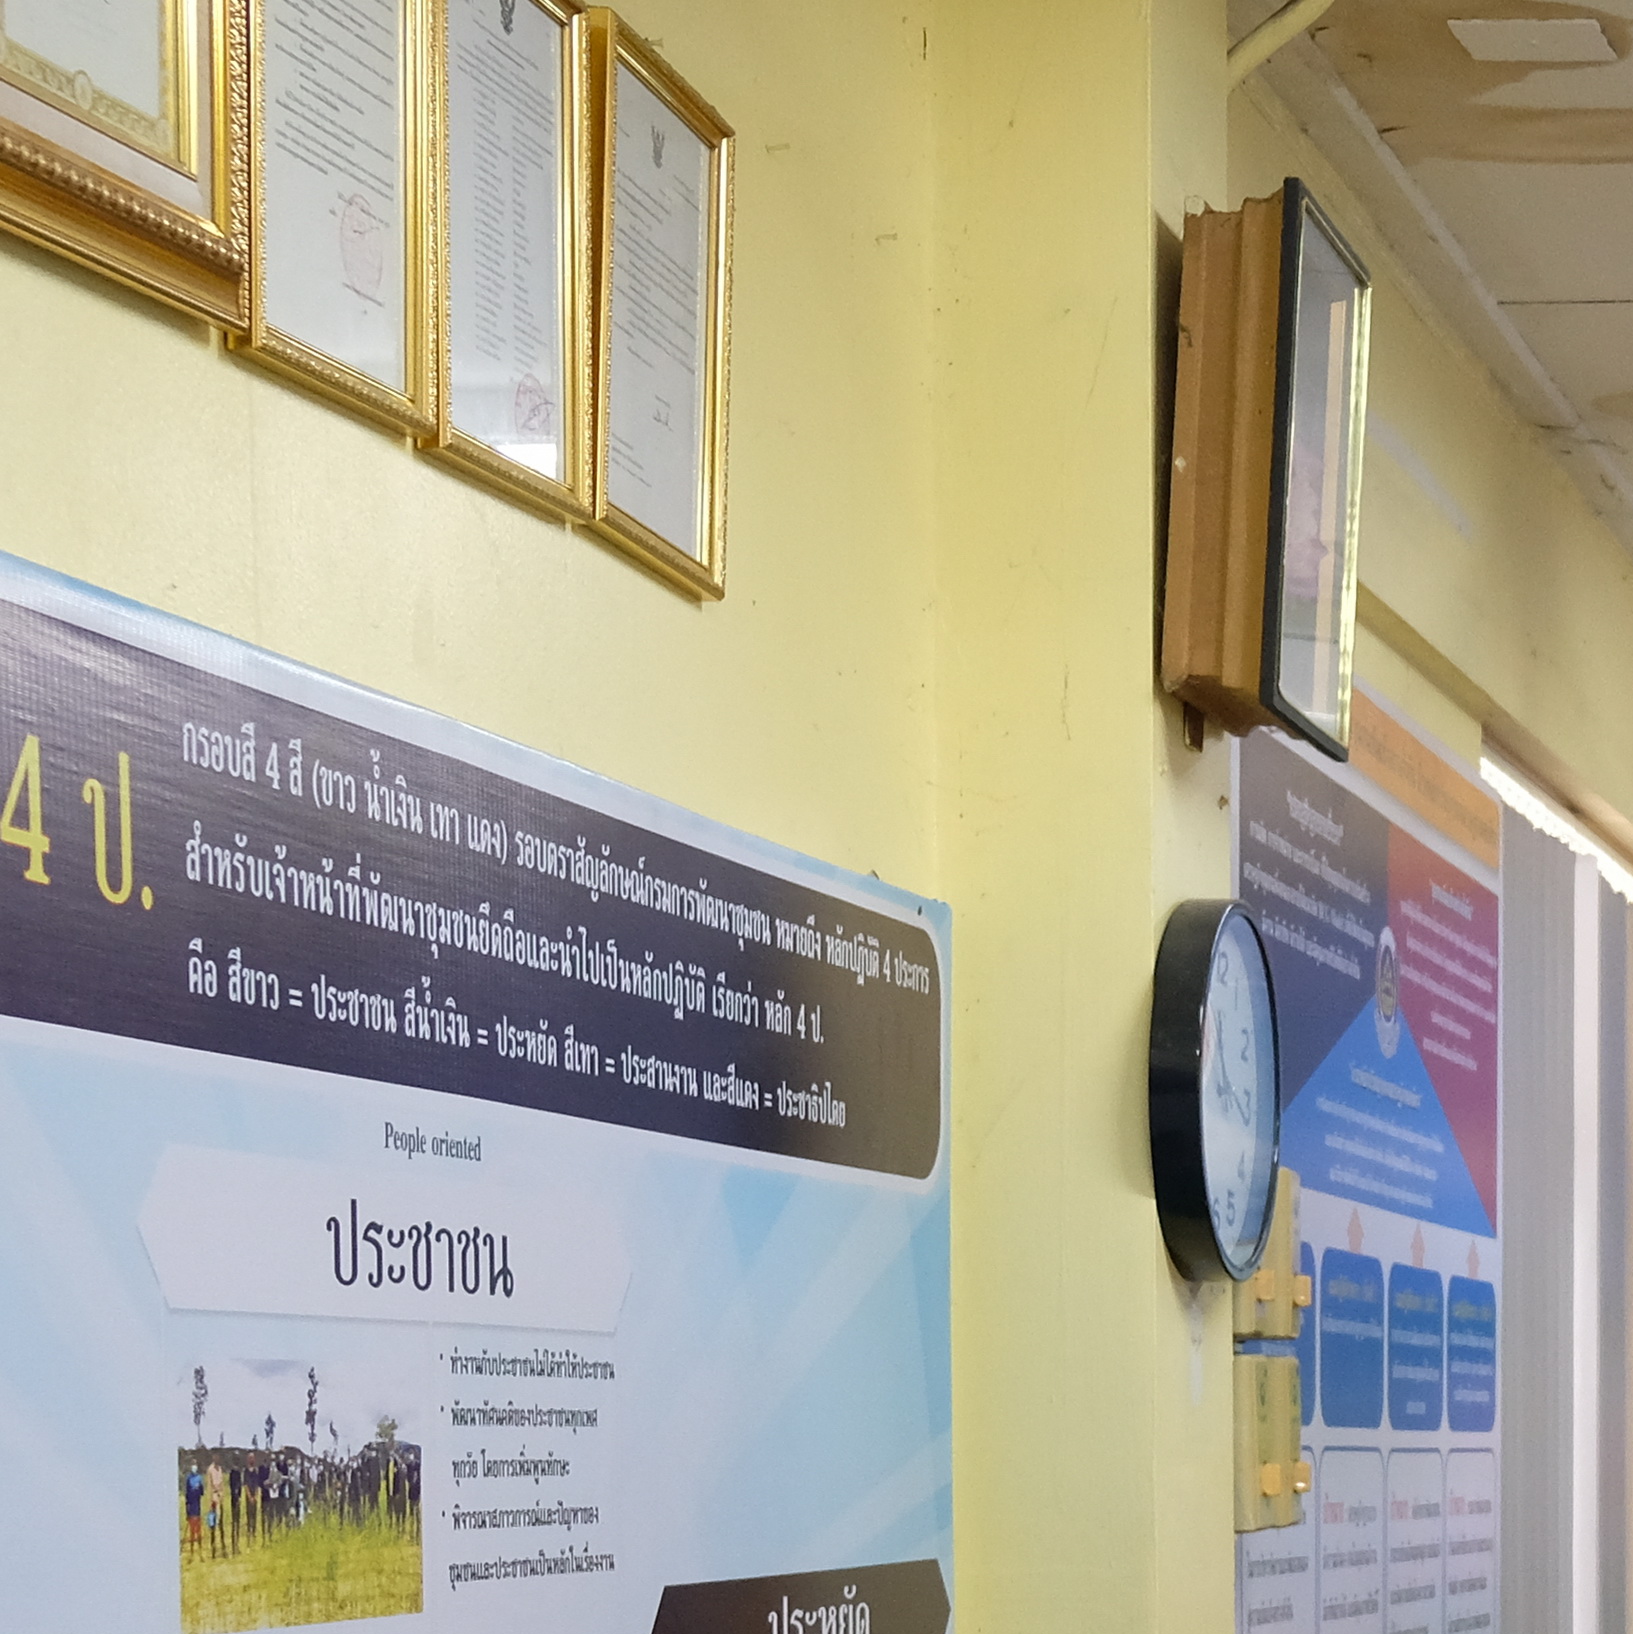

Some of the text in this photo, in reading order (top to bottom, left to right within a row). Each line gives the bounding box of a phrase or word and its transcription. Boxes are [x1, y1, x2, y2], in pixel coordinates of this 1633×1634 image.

[0, 734, 154, 911] 4 ป.
[183, 721, 256, 783] กรอบสี
[265, 742, 281, 791] 4
[289, 737, 303, 797] สี
[312, 758, 357, 815] (ขาว
[366, 748, 423, 833] น้ำเงิน
[430, 799, 460, 846] เทา
[467, 814, 507, 865] แดง)
[882, 950, 892, 982] 4
[187, 937, 218, 998] คือ
[228, 947, 281, 1010] สีขาว
[311, 975, 398, 1034] ประชาชน
[404, 975, 471, 1049] สีน้ำเงิน
[495, 1015, 558, 1068] ประหยัด
[564, 1025, 599, 1077] สีเทา
[765, 988, 792, 1036] หลัก
[796, 1003, 806, 1043] 4
[383, 1121, 482, 1162] People oriented
[326, 1198, 515, 1299] ประชาชน
